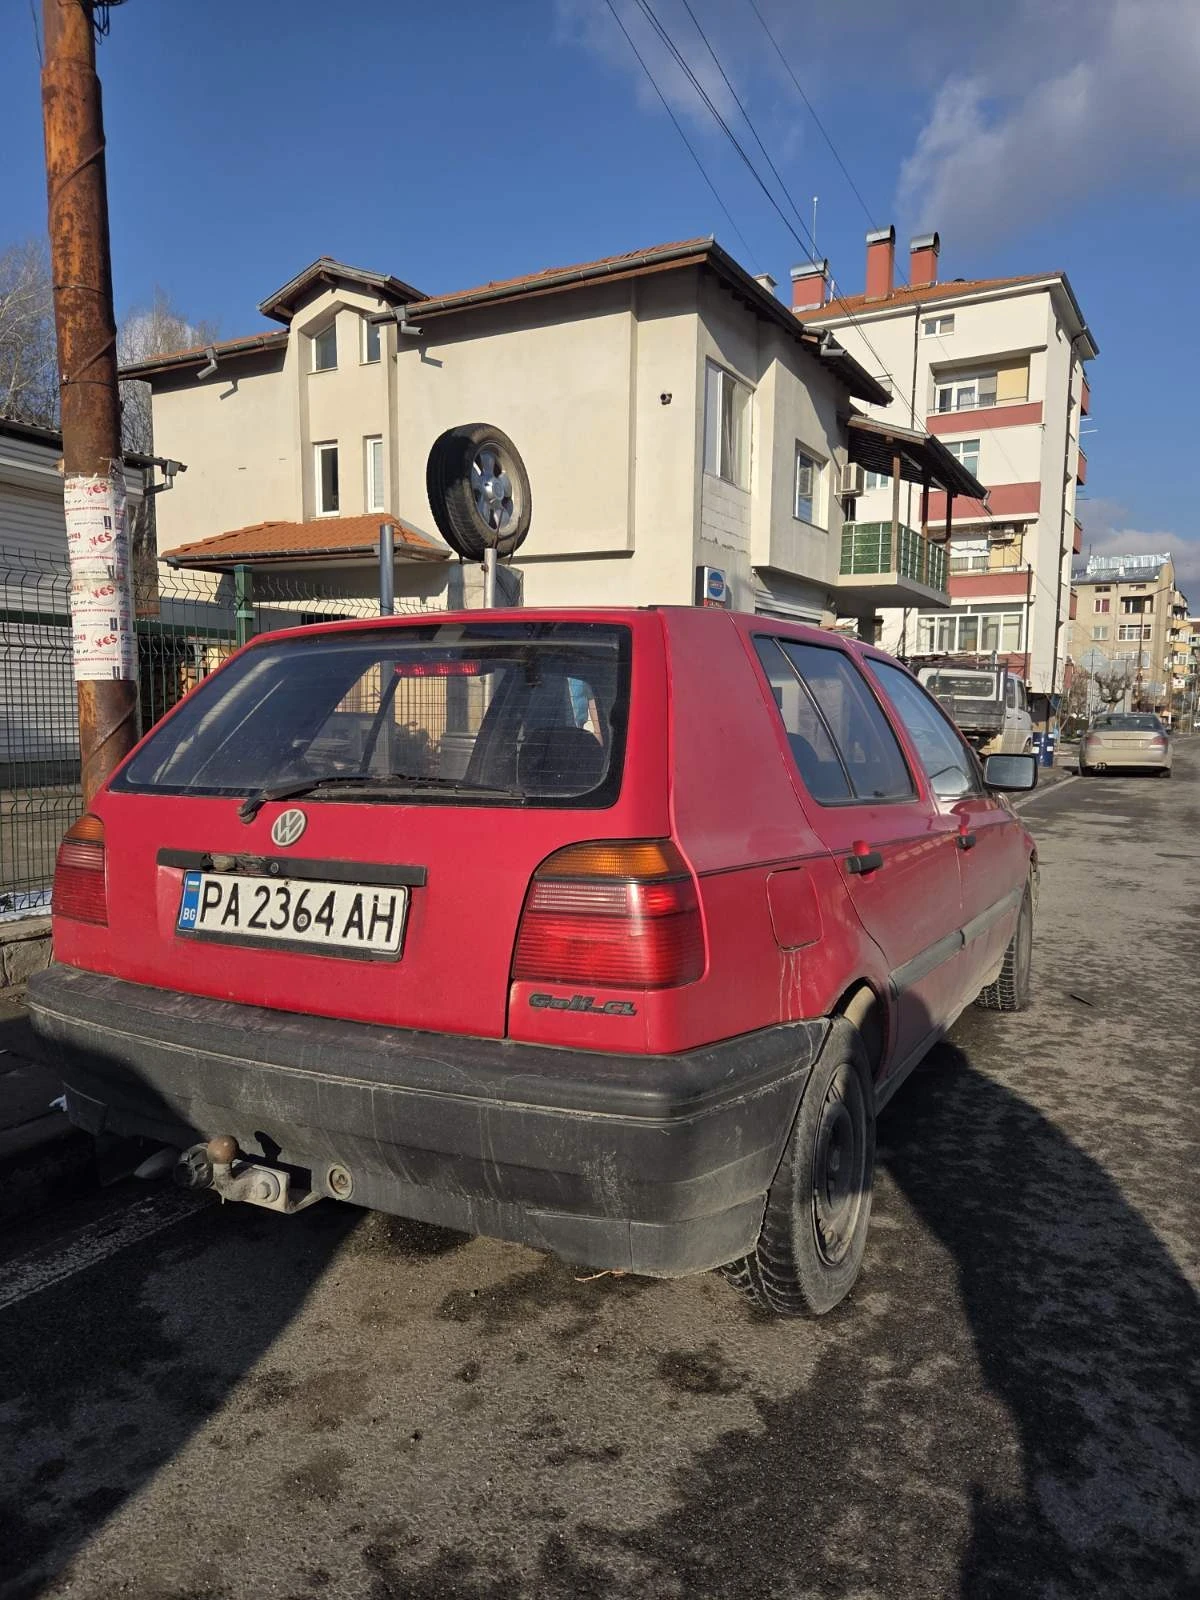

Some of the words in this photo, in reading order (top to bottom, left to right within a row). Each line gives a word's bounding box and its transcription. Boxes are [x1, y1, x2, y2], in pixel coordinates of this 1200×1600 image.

[182, 907, 196, 922] BG
[199, 880, 240, 927] PA
[247, 885, 338, 937] 2364
[342, 892, 397, 943] AH
